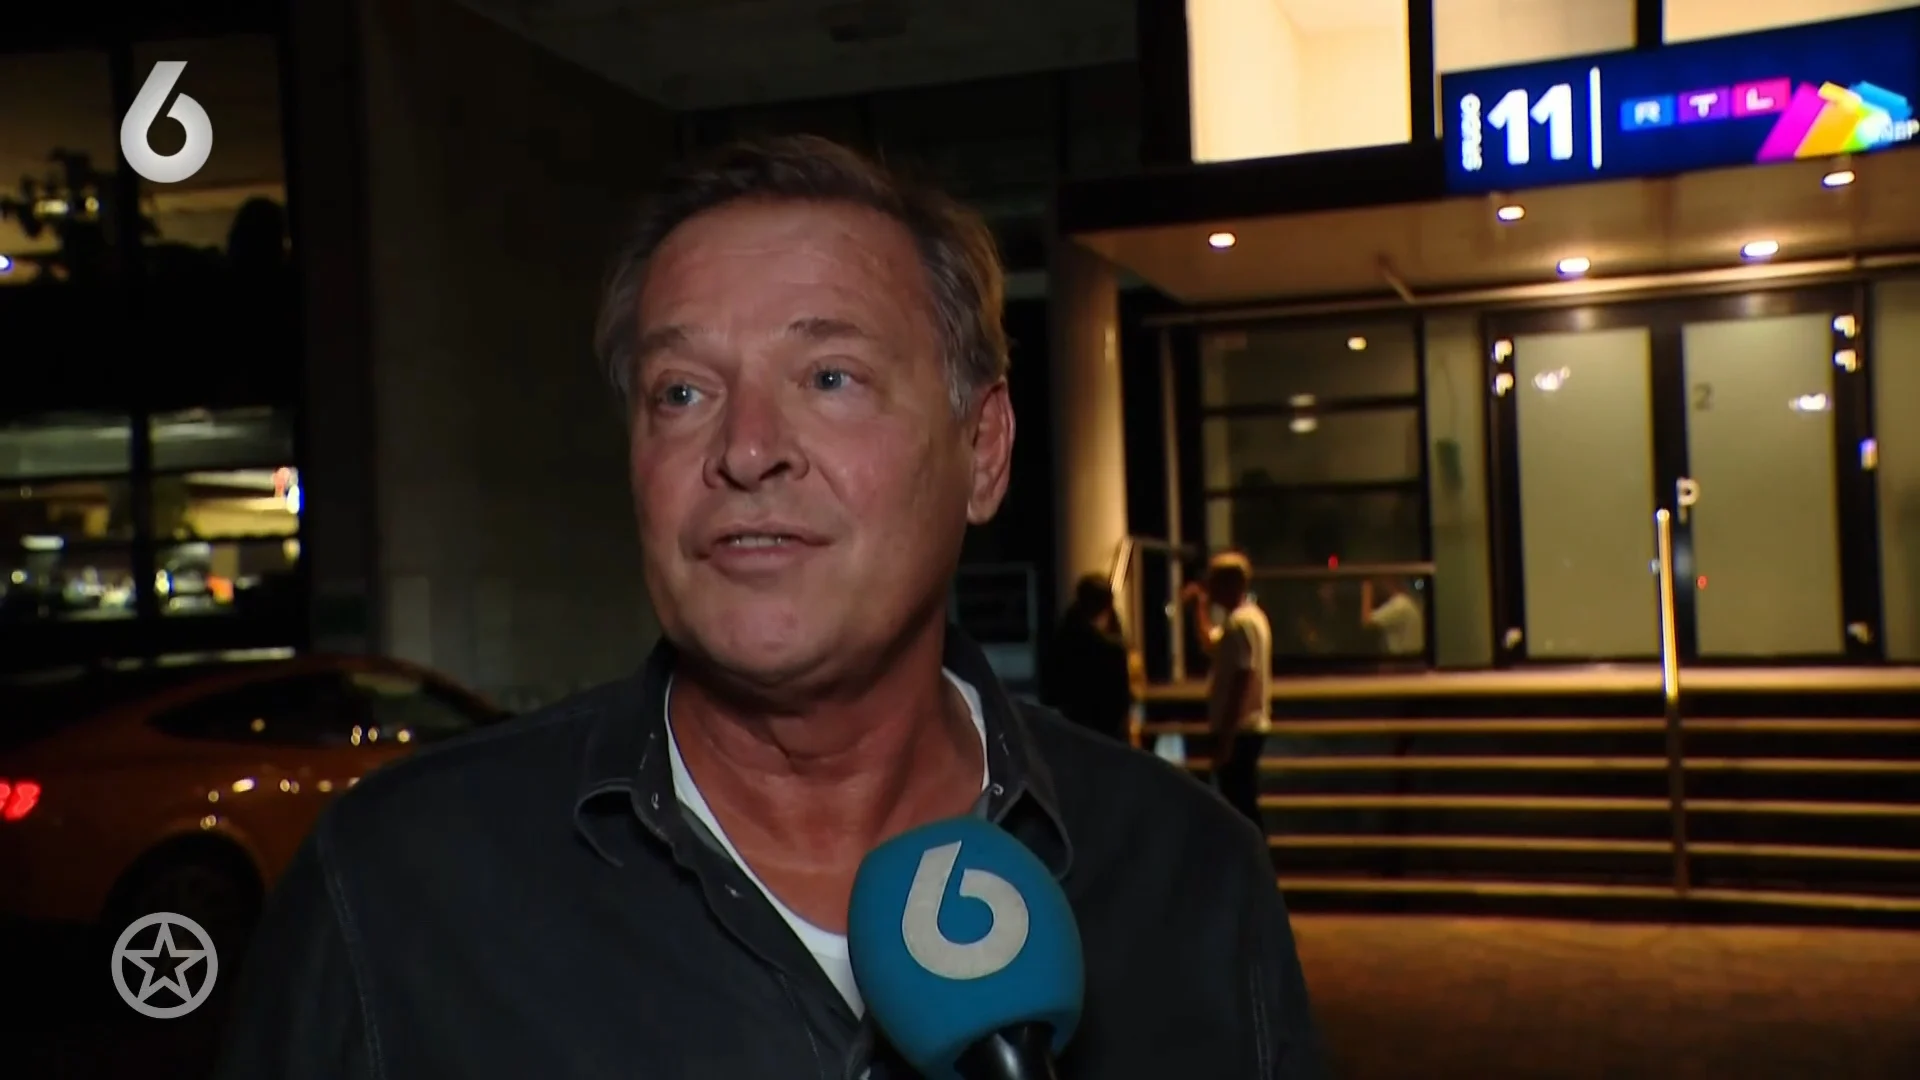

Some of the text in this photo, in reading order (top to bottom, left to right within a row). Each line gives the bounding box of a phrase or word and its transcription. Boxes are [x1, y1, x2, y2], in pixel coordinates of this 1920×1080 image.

[1487, 83, 1573, 165] 11
[1634, 87, 1775, 123] RTL
[1693, 383, 1713, 412] 2
[902, 840, 1029, 980] 6
